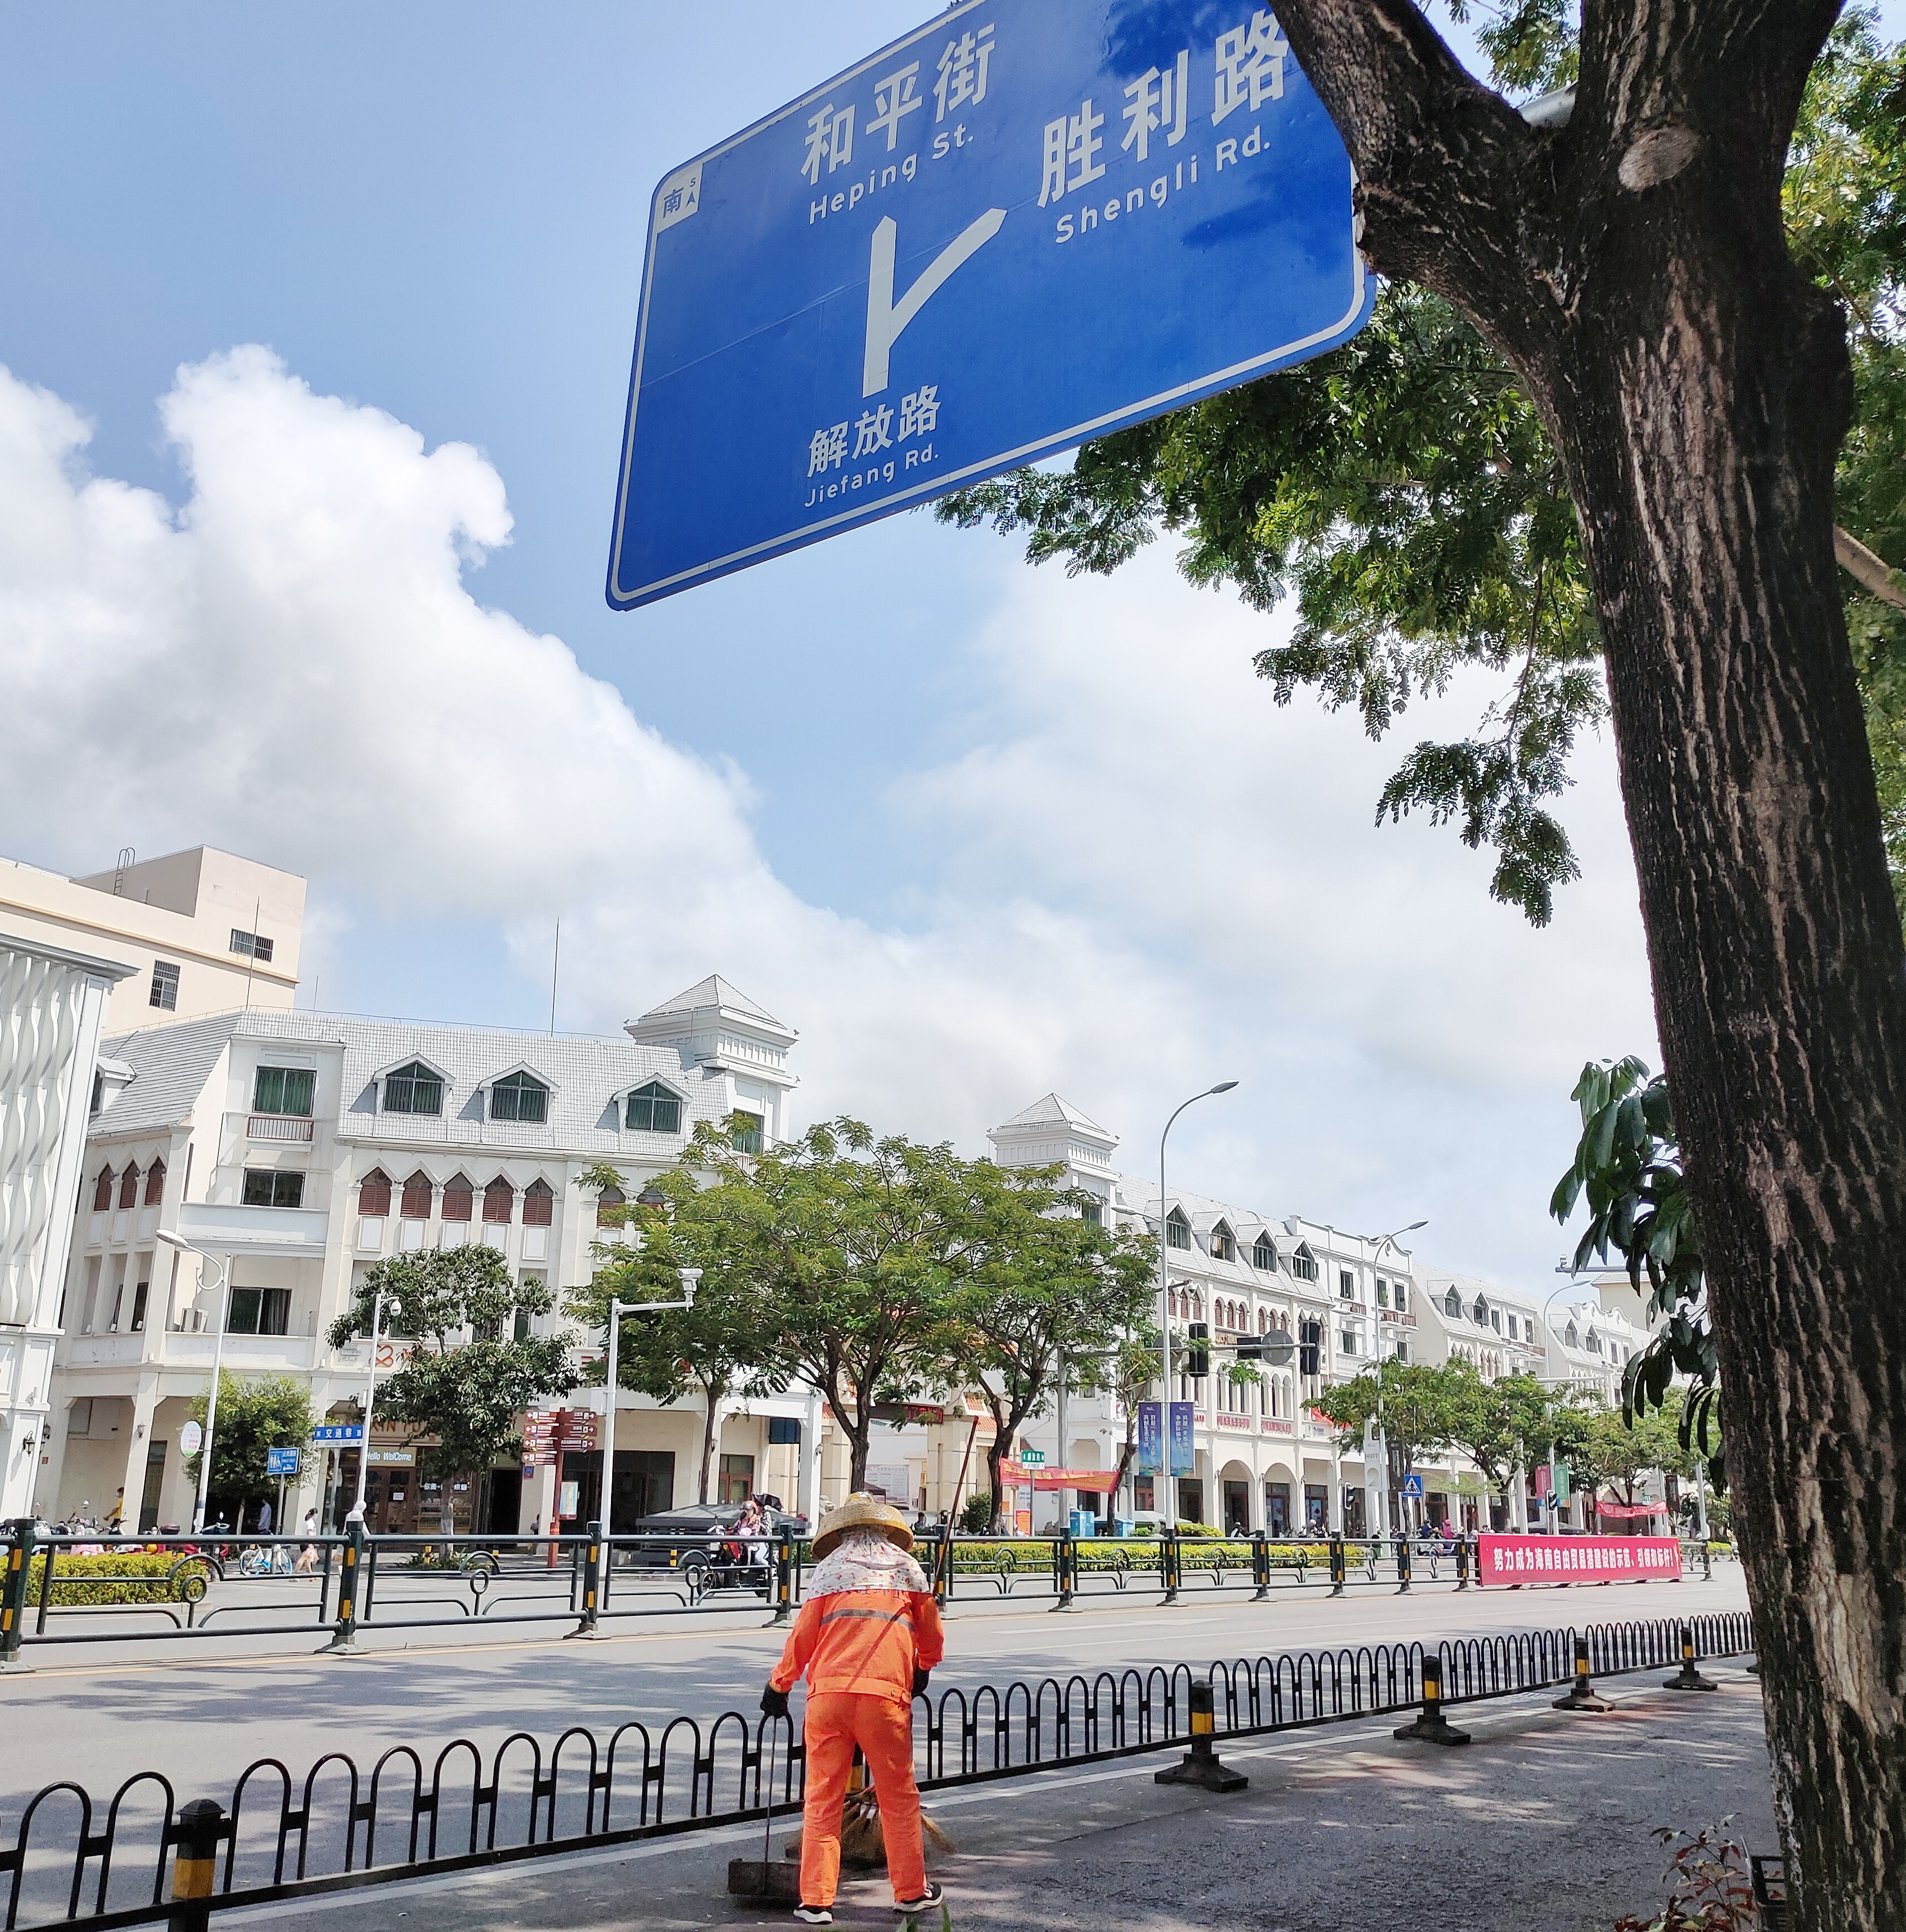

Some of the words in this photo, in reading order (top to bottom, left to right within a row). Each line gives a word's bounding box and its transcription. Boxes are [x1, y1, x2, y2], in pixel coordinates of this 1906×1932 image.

[801, 22, 996, 185] 和平街
[1037, 9, 1289, 208] 胜利路
[663, 186, 684, 219] 南
[690, 177, 696, 187] S
[809, 153, 918, 225] Heping
[932, 123, 974, 160] St.
[1055, 155, 1198, 244] Shengli
[1217, 124, 1270, 170] Rd.
[804, 459, 895, 508] Jiefang
[905, 443, 940, 470] Rd.
[807, 385, 941, 477] 解放路
[325, 1427, 353, 1438] 交通巷
